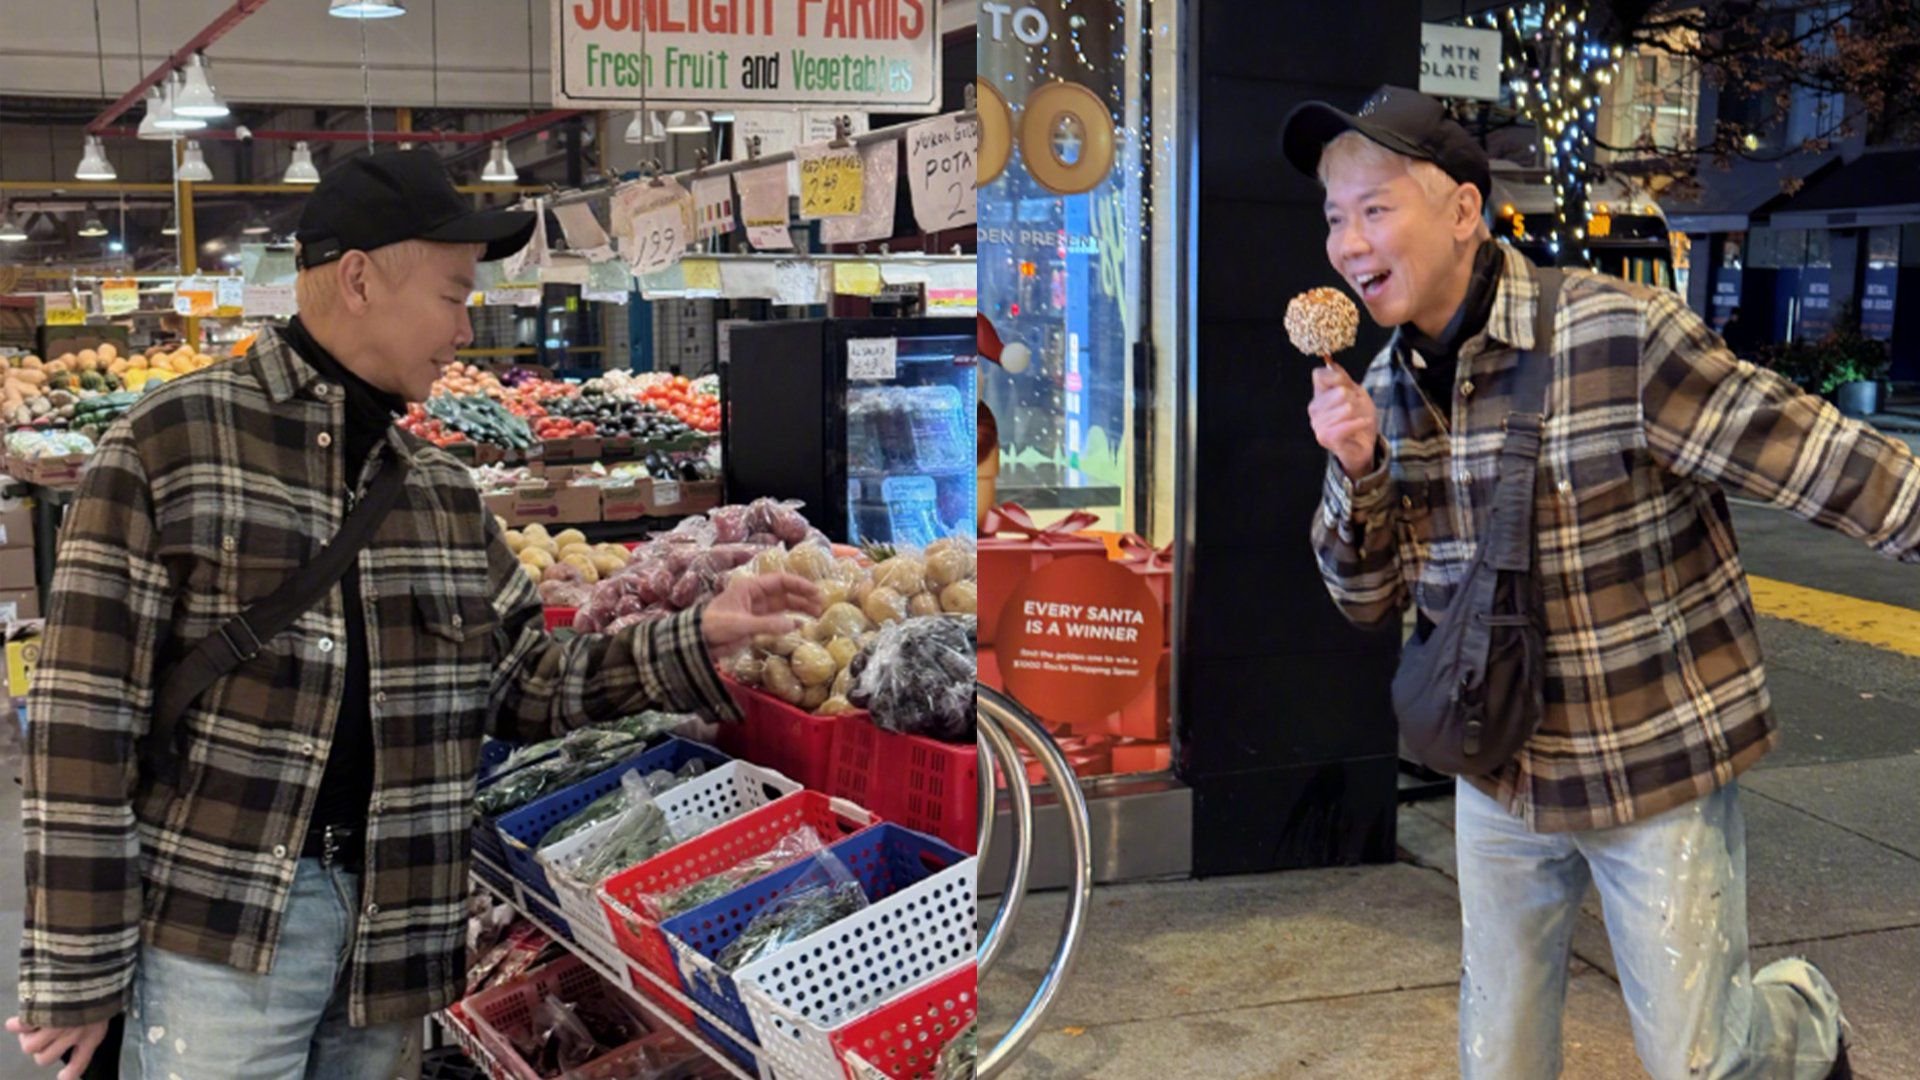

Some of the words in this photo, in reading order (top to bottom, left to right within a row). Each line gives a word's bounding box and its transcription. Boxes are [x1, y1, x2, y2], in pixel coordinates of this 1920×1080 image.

[982, 2, 1048, 45] TO
[586, 44, 653, 88] Fresh
[665, 46, 729, 89] Fruit
[741, 51, 780, 90] and
[791, 49, 913, 93] Vegetables
[1440, 43, 1480, 61] MTN
[925, 147, 977, 191] POTA
[1023, 600, 1083, 619] EVERY
[1087, 606, 1144, 624] SANTA
[1025, 619, 1043, 634] IS
[1046, 621, 1060, 636] A
[1065, 622, 1138, 642] WINNER
